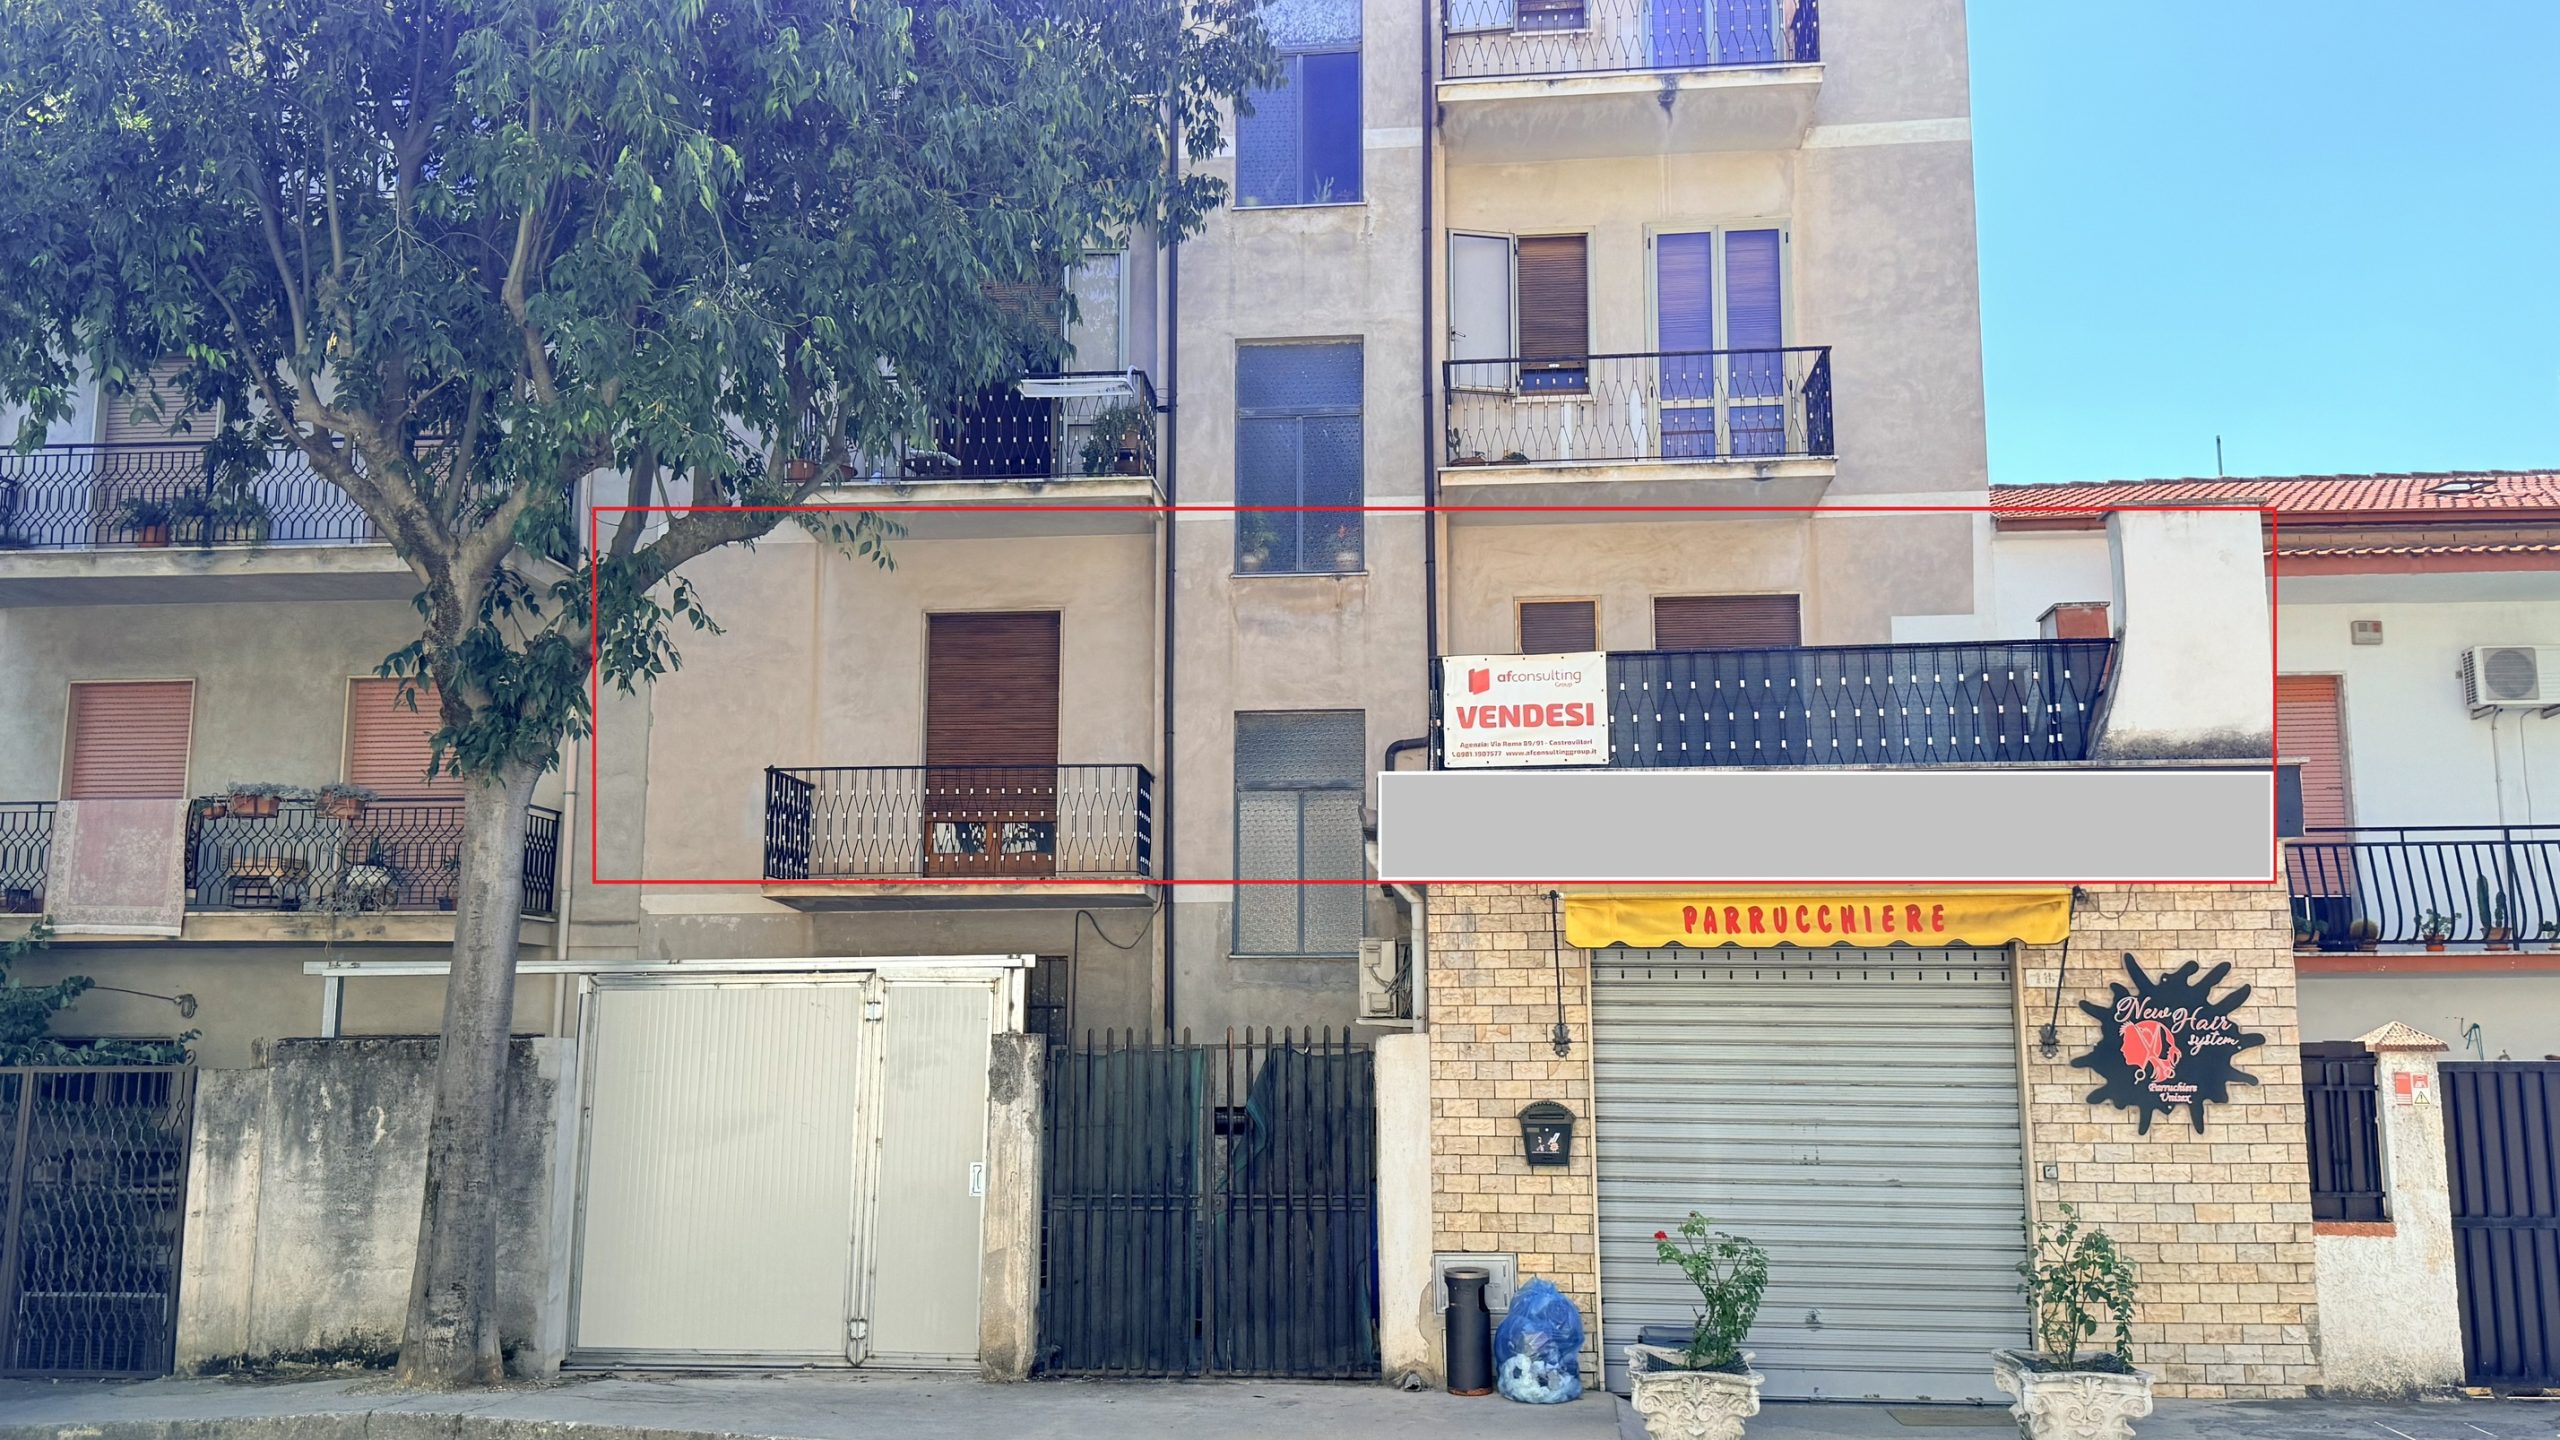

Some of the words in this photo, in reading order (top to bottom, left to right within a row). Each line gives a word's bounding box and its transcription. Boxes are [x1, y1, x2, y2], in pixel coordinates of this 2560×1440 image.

[1497, 668, 1582, 683] afconsulting
[1456, 702, 1595, 729] VENDESI
[1682, 903, 1946, 935] PARRUCCHIERE
[2114, 996, 2172, 1022] New
[2171, 1007, 2233, 1034] Hair
